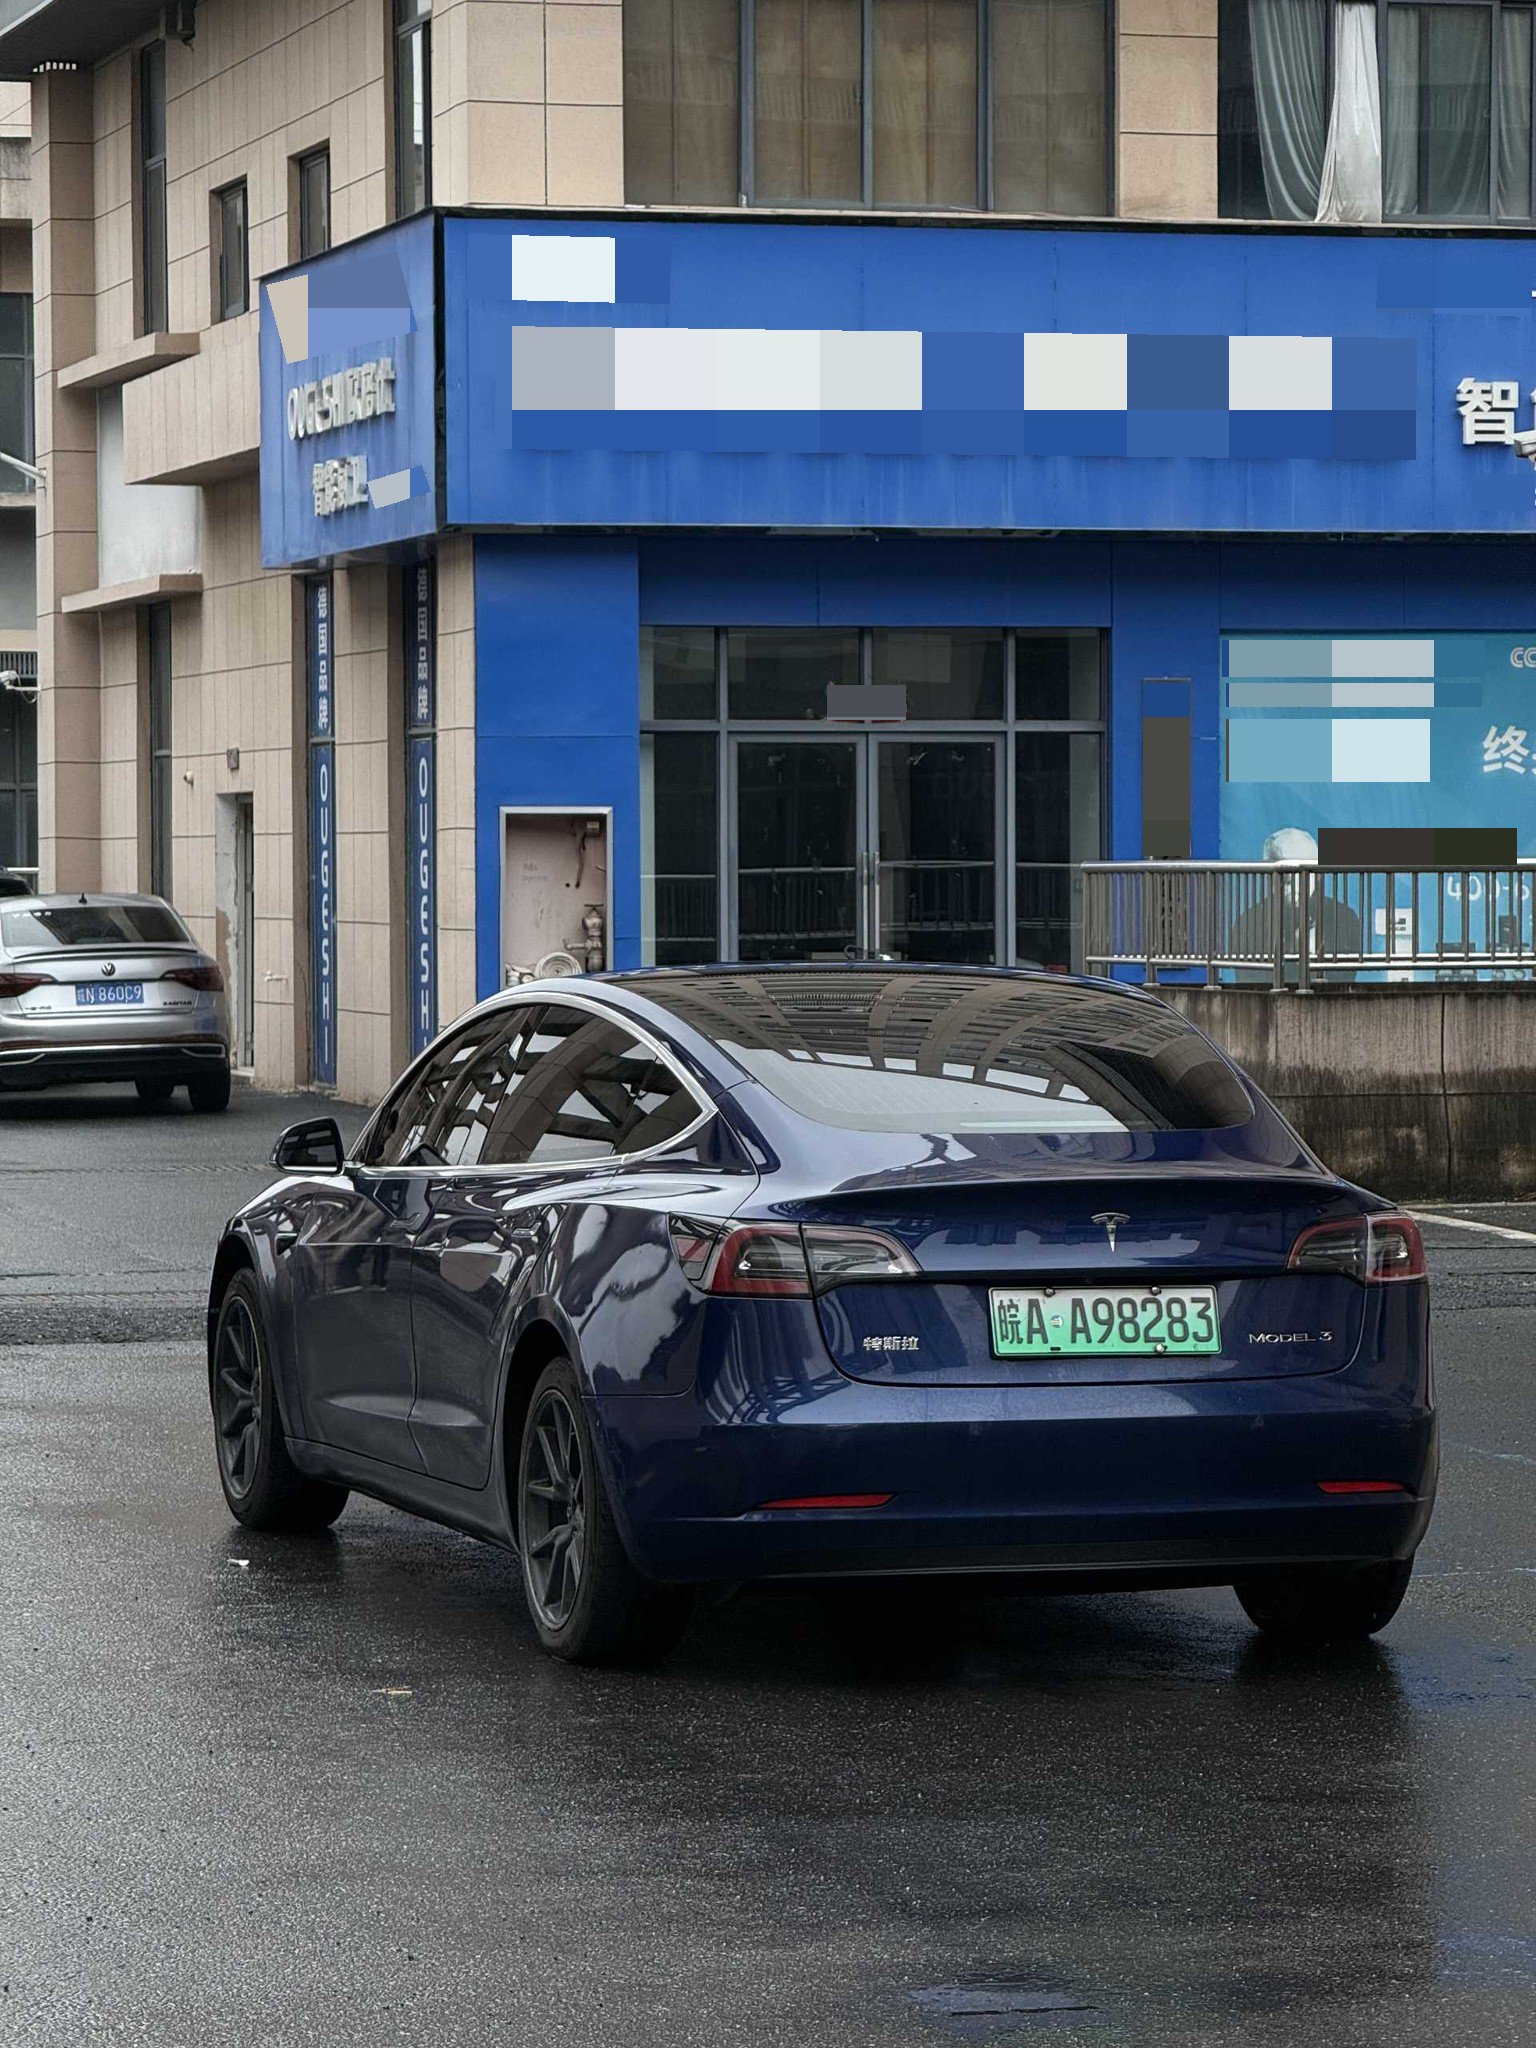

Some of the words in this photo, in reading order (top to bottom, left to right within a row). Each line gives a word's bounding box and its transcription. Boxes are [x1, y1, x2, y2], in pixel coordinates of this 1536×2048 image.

[1456, 378, 1536, 446] 智
[1482, 725, 1536, 775] 终
[319, 763, 330, 1064] OUGESHI
[419, 756, 430, 1049] OUGESH
[863, 1336, 919, 1351] 特斯拉
[1248, 1333, 1316, 1344] MODEL
[1319, 1331, 1333, 1341] 3
